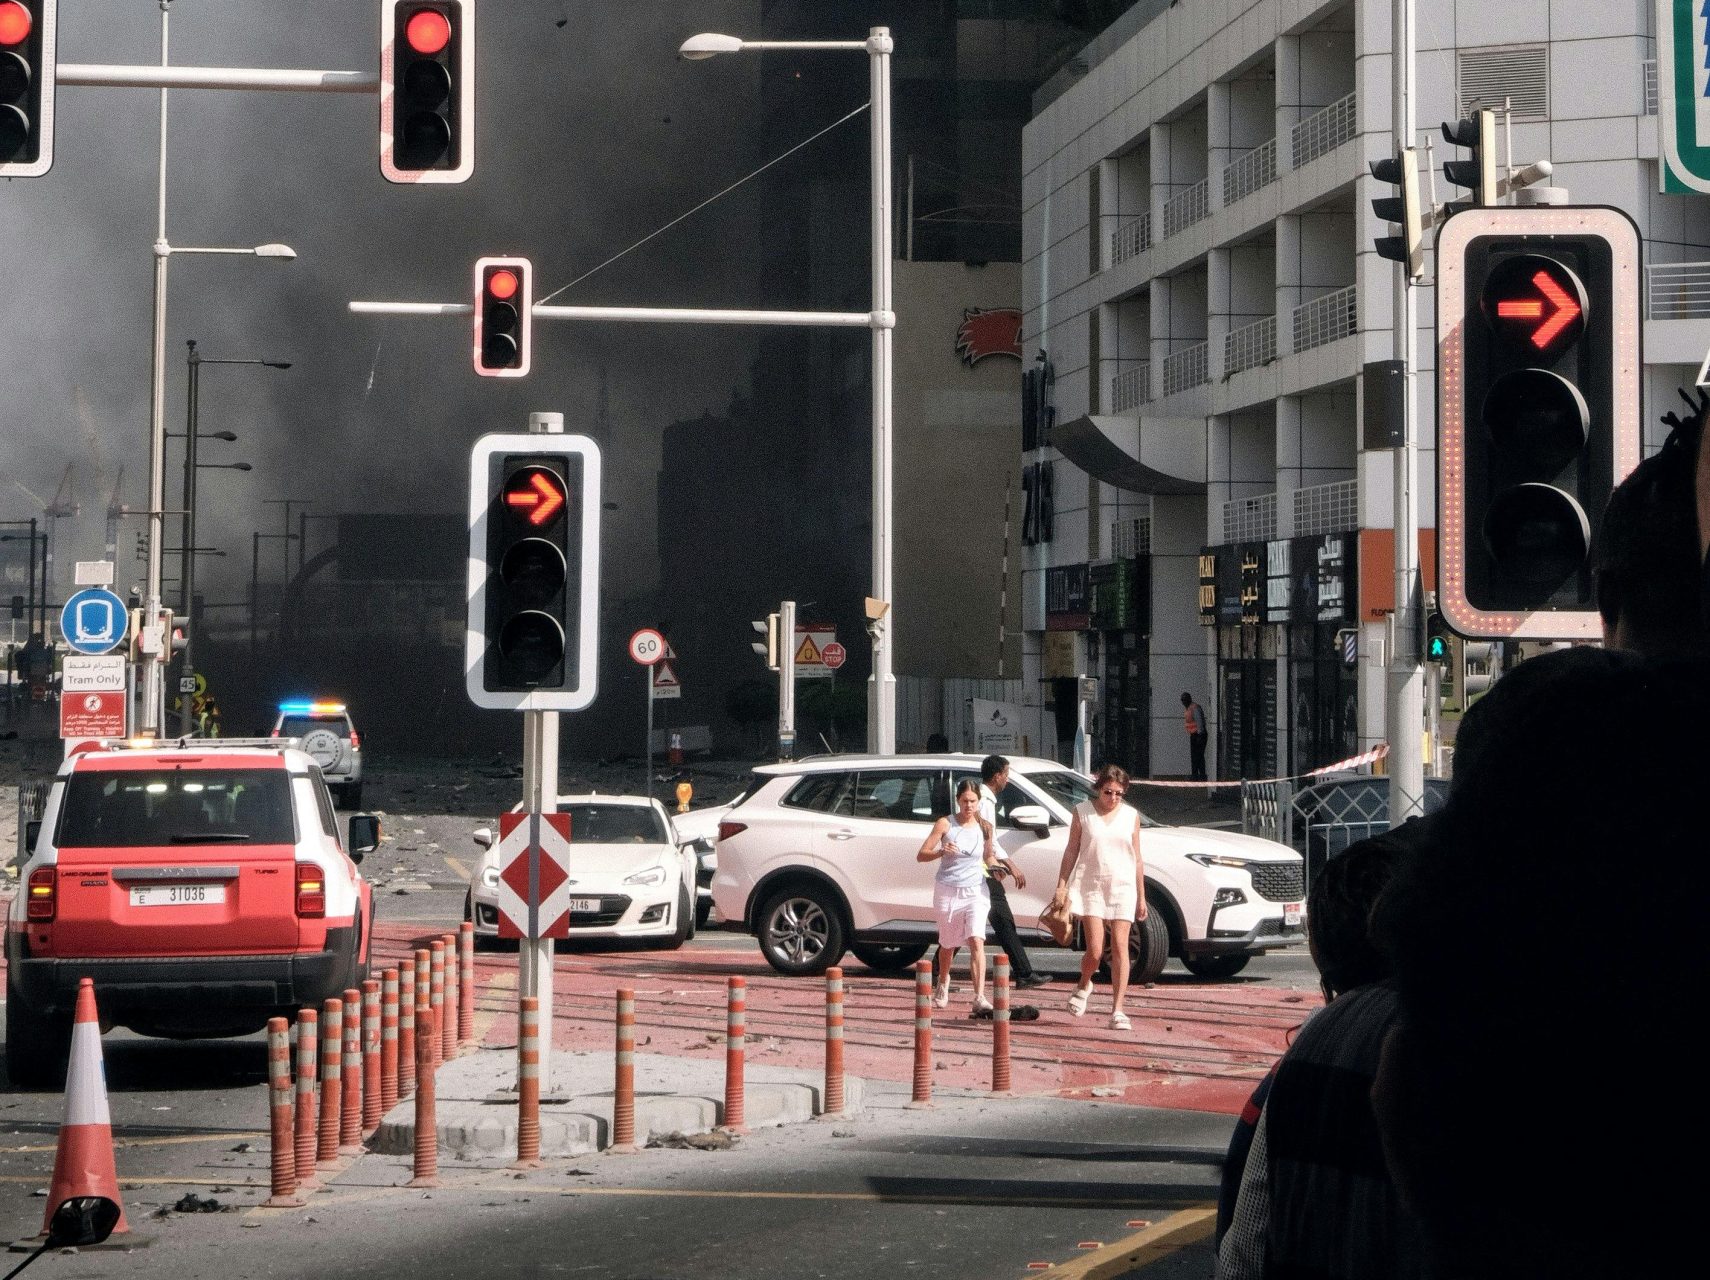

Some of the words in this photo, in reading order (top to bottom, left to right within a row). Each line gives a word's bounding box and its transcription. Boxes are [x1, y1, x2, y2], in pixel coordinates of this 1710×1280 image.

[638, 639, 657, 654] 60
[68, 675, 94, 685] Tram
[96, 674, 121, 685] Only
[181, 680, 195, 690] 45
[170, 887, 205, 901] 31036
[139, 895, 146, 904] E
[570, 901, 589, 910] 2146
